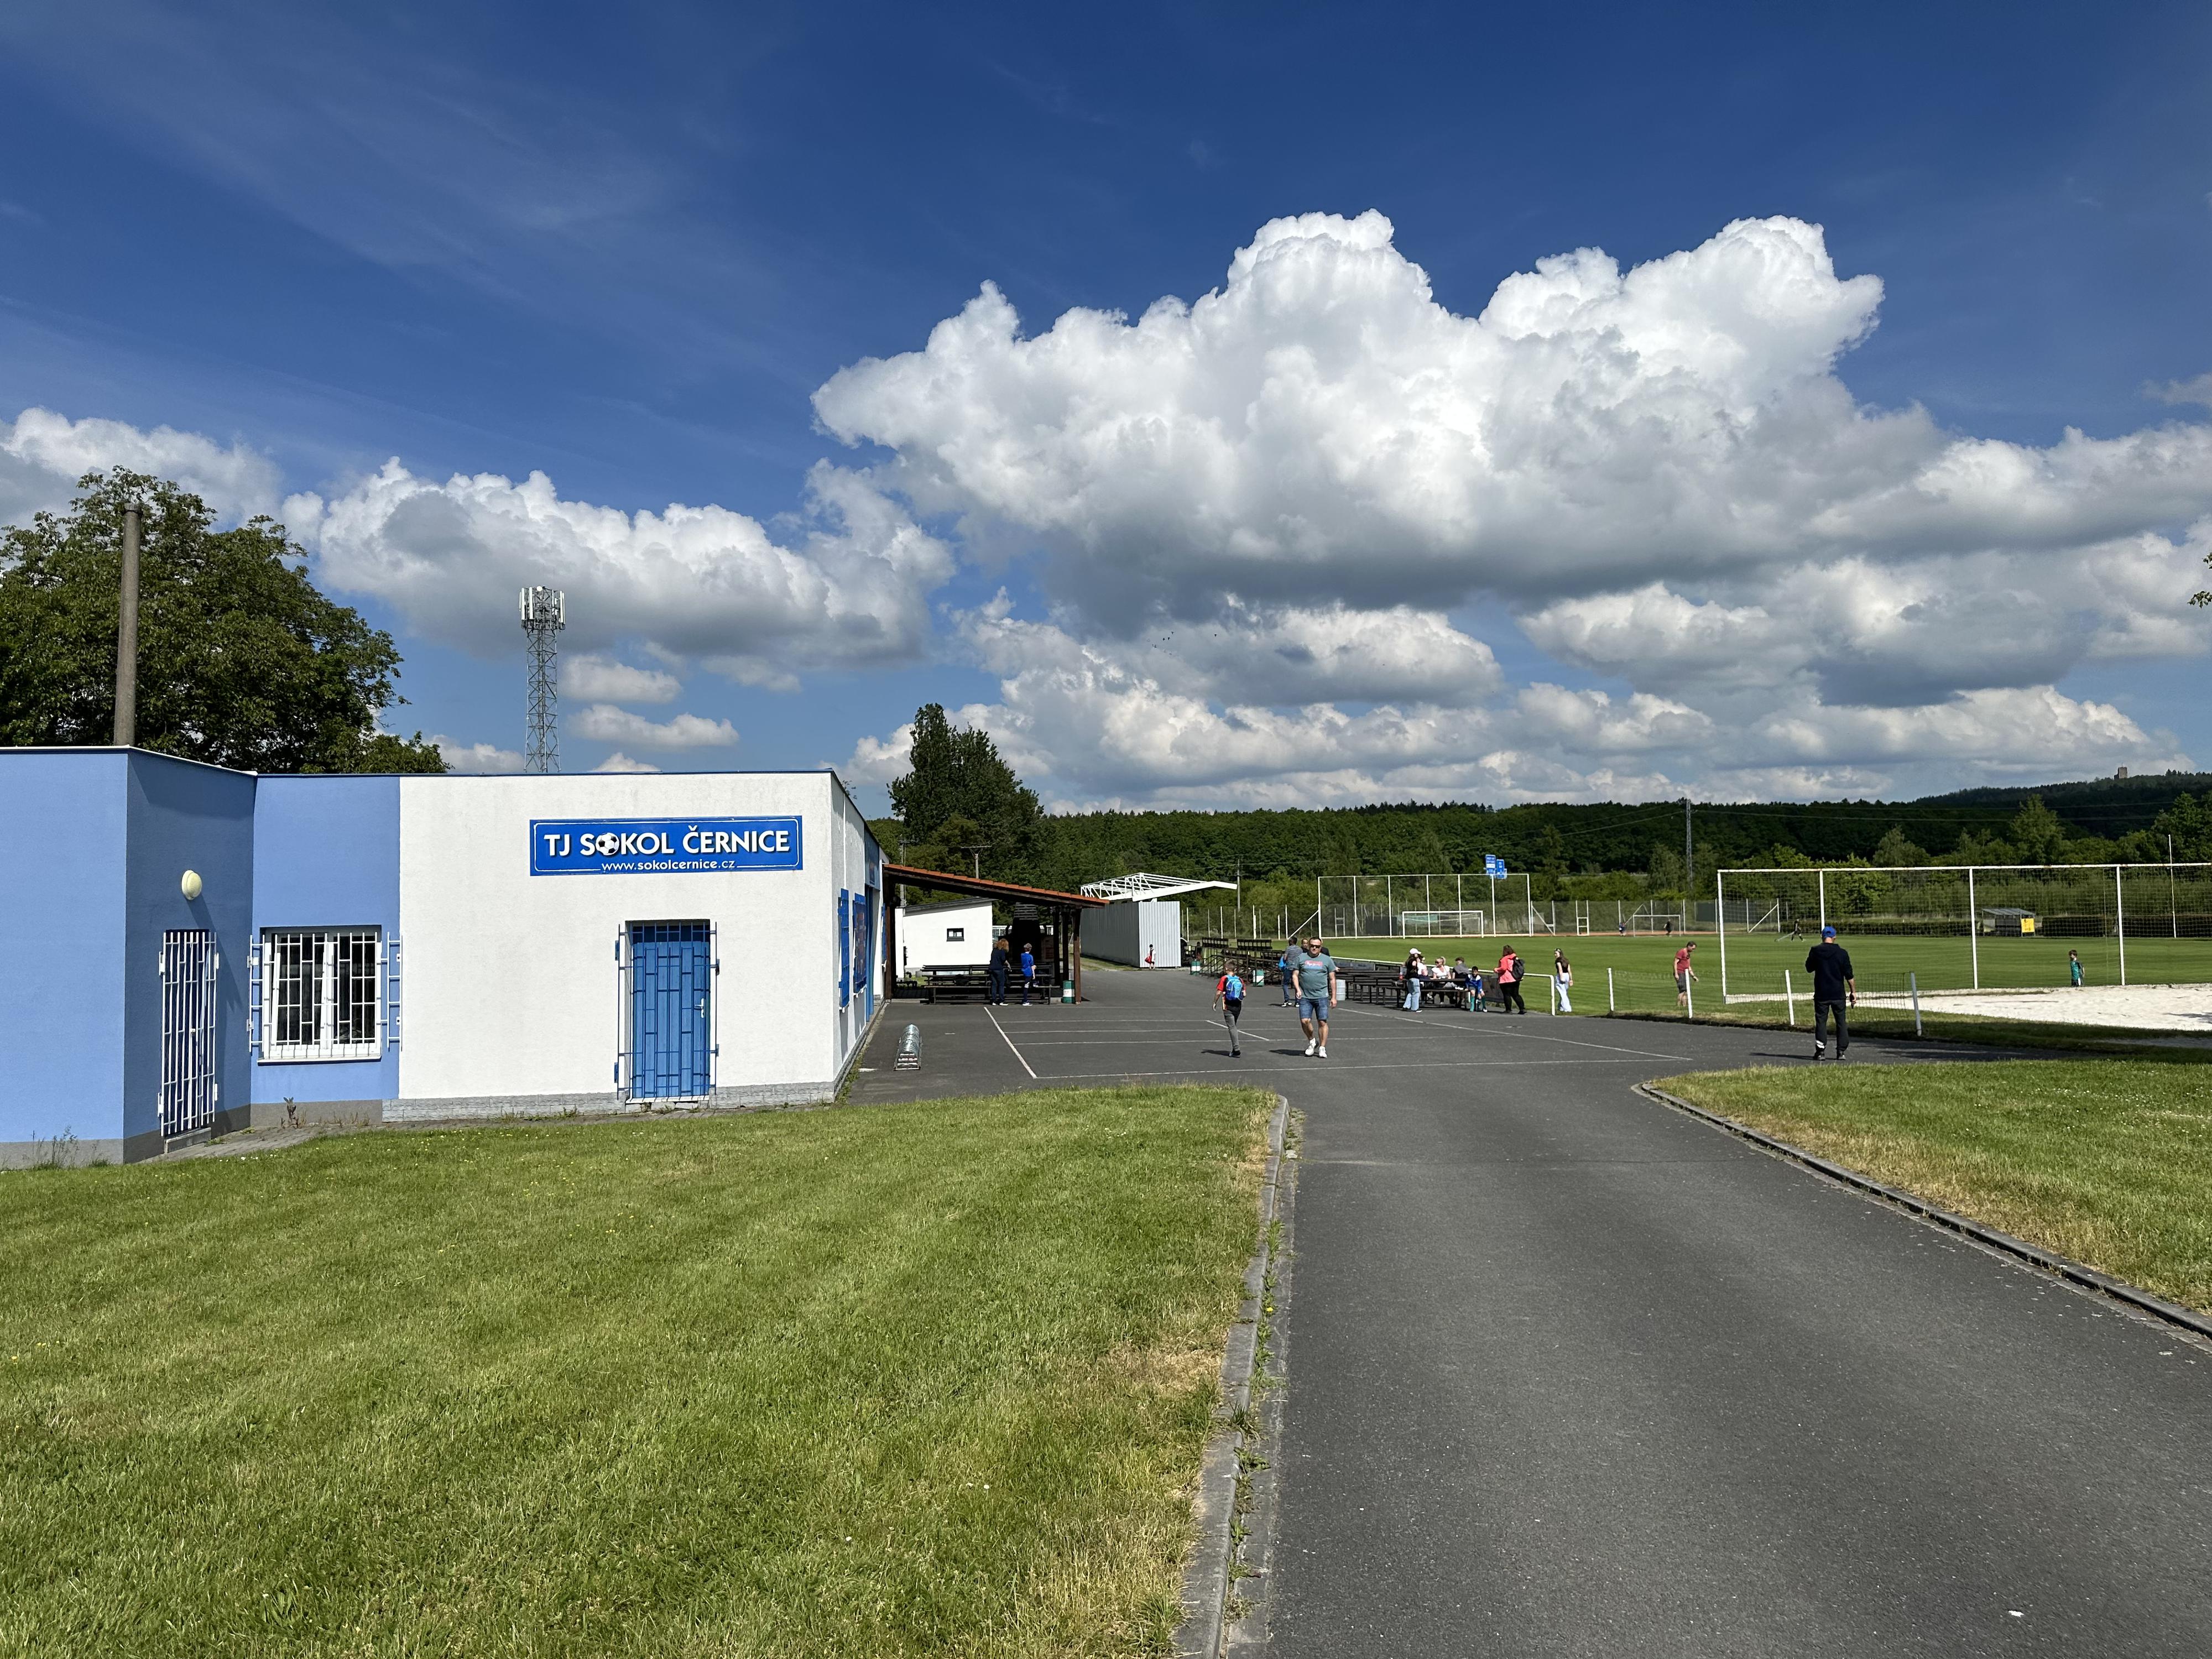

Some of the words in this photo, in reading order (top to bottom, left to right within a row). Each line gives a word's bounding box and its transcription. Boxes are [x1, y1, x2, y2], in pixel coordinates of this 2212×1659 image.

[544, 834, 570, 855] TJ
[581, 833, 674, 855] SOKOL
[683, 825, 790, 853] ČERNICE
[602, 859, 734, 870] www.sokolcernice.cz
